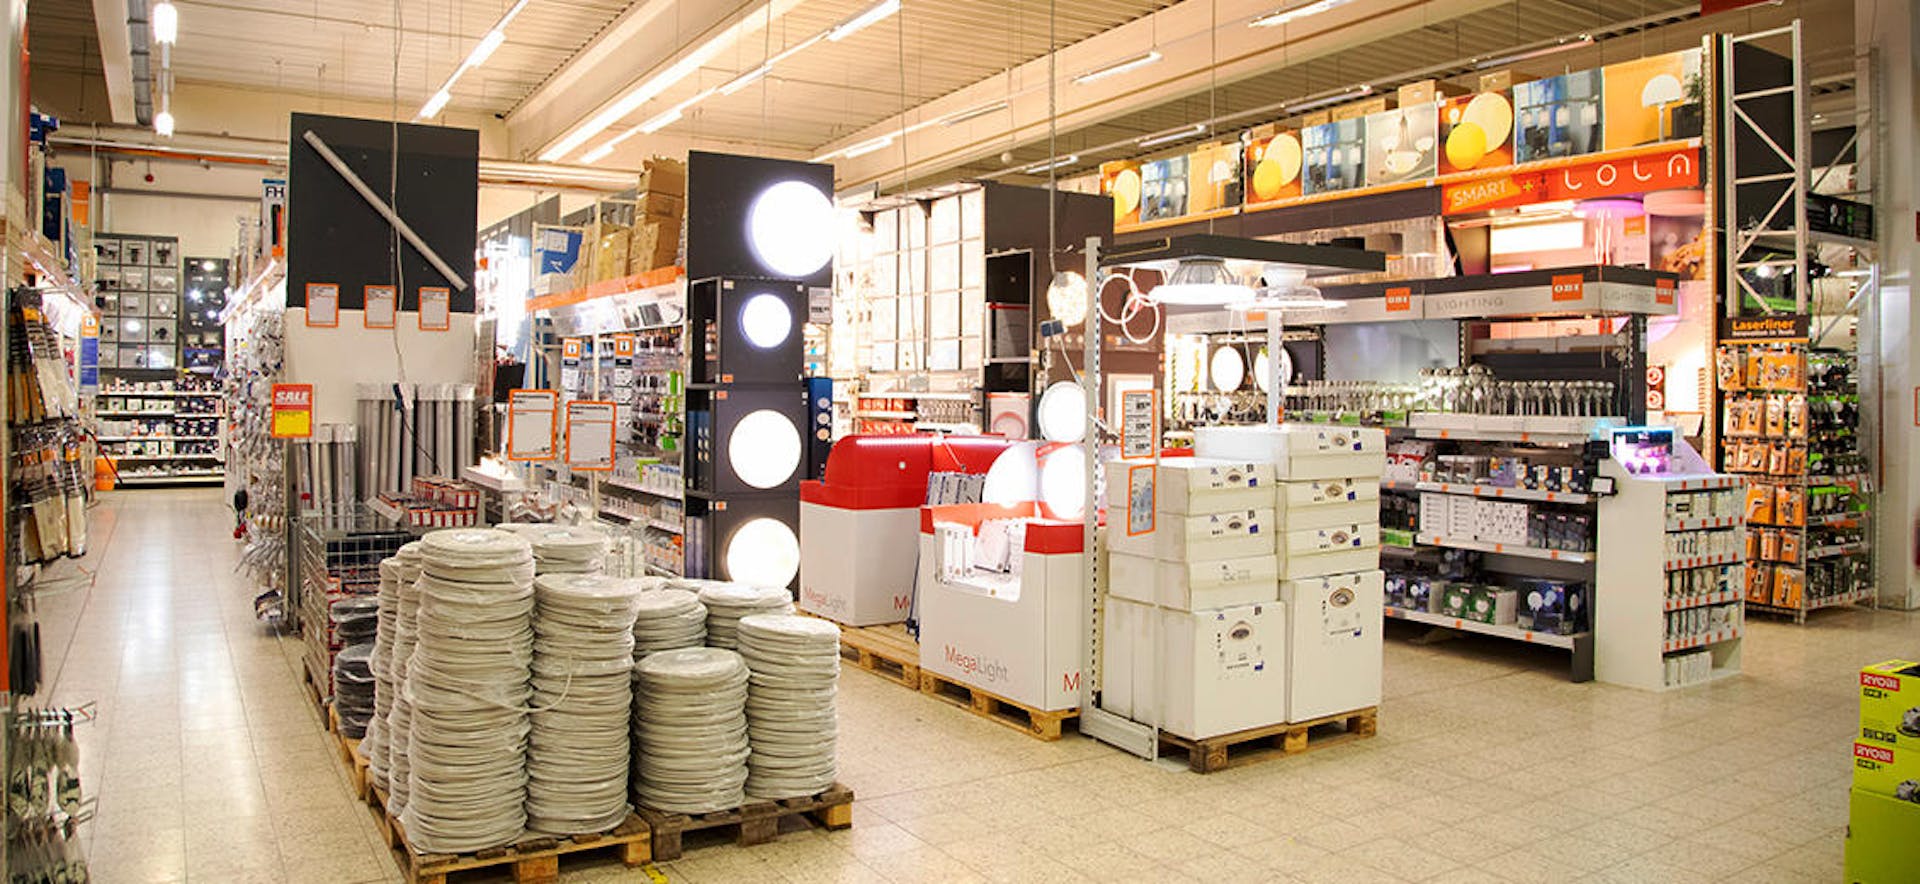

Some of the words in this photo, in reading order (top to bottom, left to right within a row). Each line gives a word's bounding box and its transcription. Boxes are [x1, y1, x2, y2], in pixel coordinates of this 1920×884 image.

[1453, 180, 1508, 207] SMART
[1554, 283, 1581, 293] OBI
[1436, 296, 1504, 310] LIGHTING
[1732, 318, 1796, 331] Laserliner
[276, 391, 309, 404] SALE
[804, 586, 847, 612] MegaLight
[945, 645, 1008, 682] MegaLight
[1863, 674, 1898, 689] RYOBI
[1857, 745, 1892, 760] RYOBI
